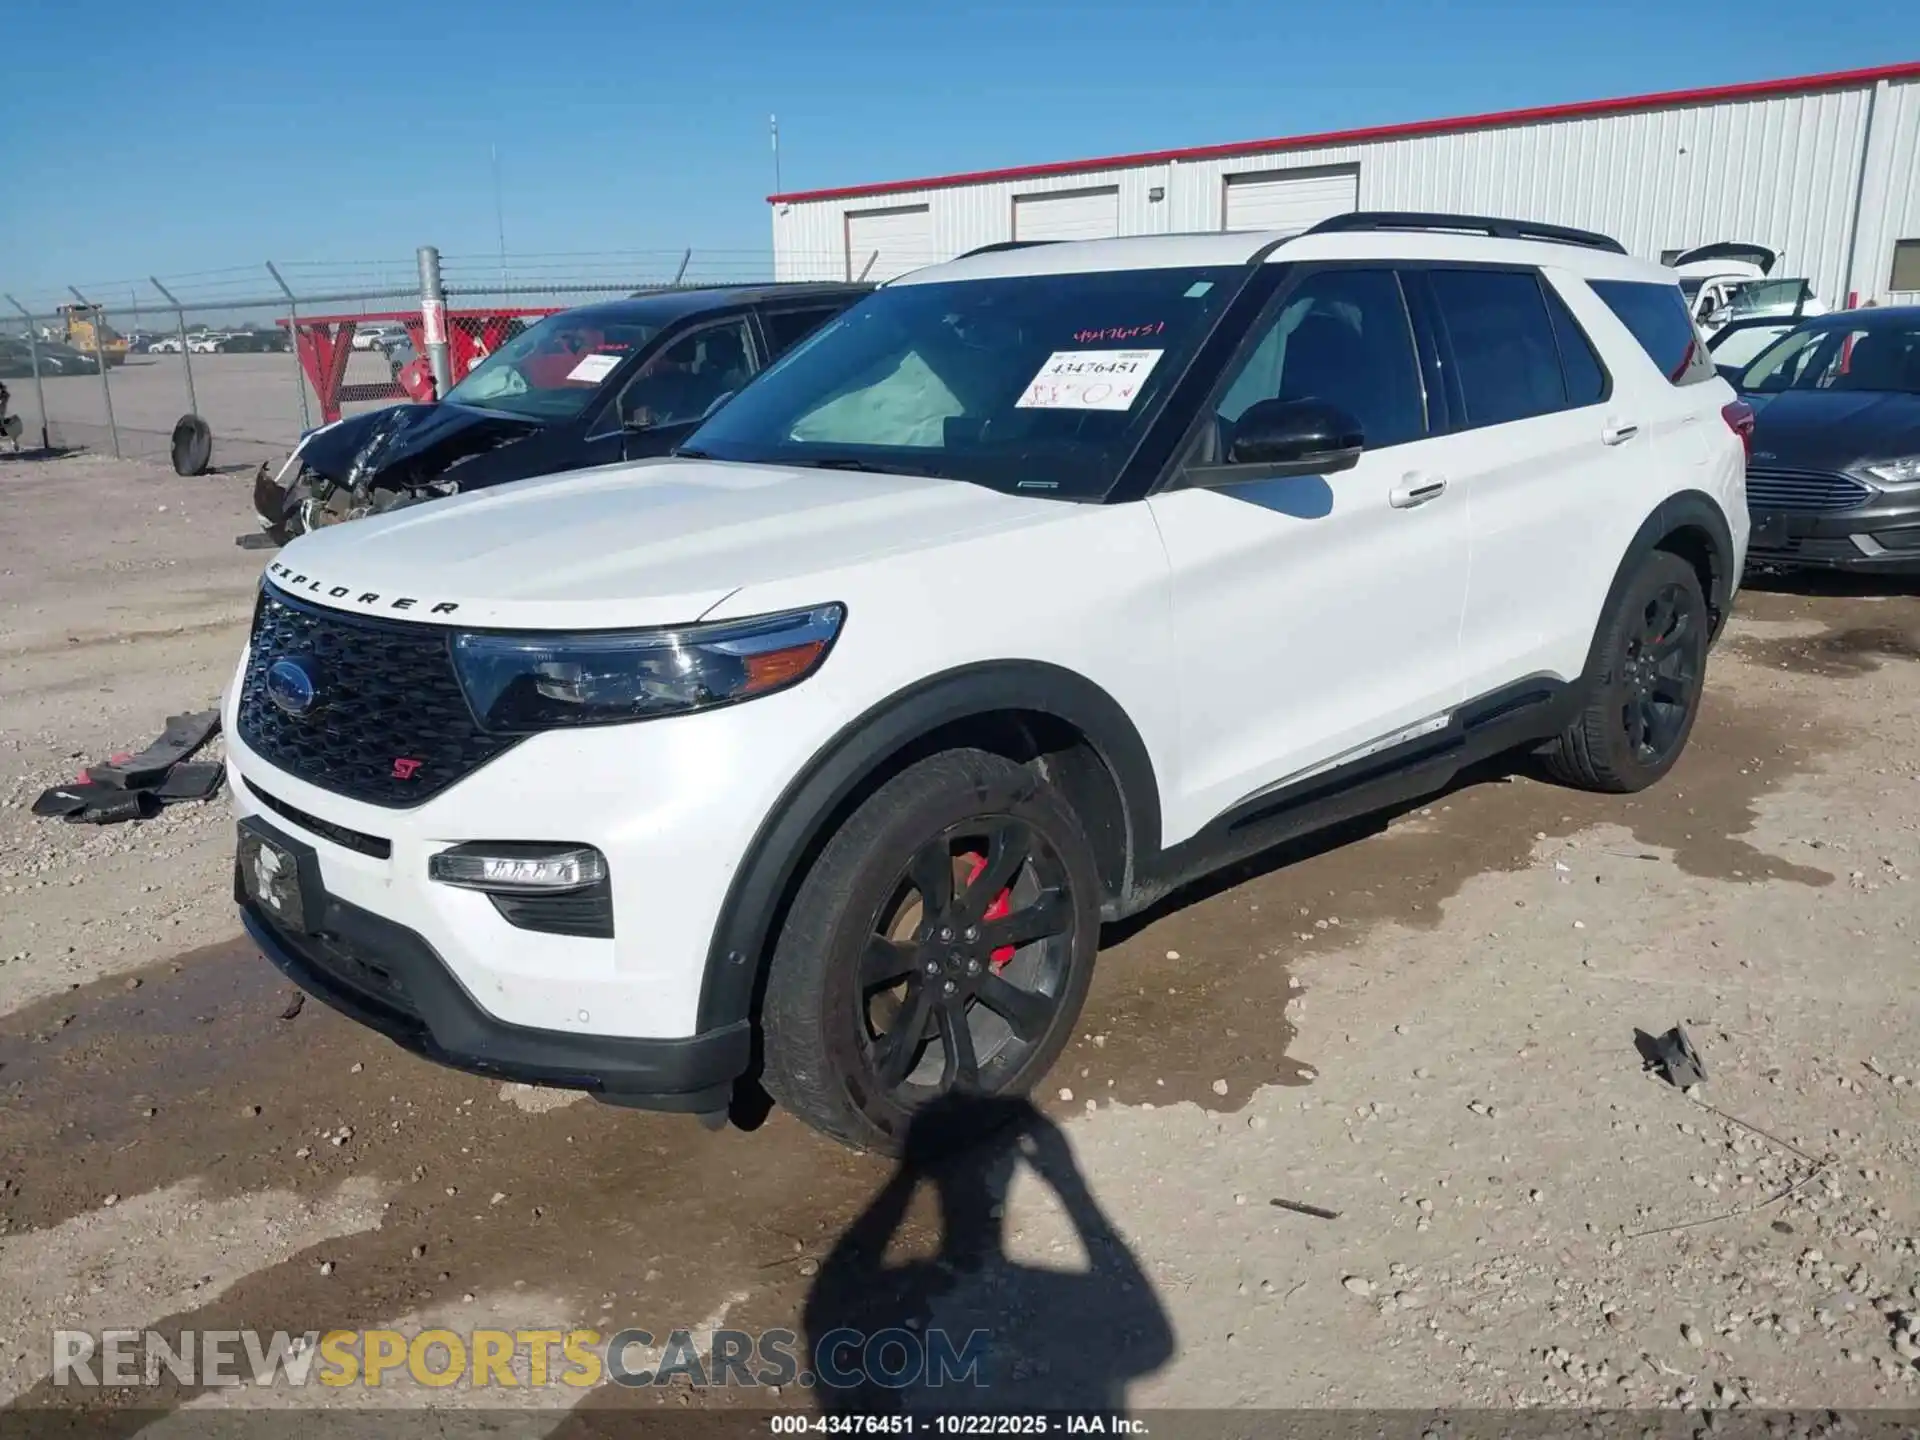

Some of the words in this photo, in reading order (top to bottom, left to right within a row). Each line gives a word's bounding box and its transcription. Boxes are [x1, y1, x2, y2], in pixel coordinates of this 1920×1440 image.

[1051, 362, 1138, 374] 43476451
[270, 562, 459, 614] EXPLORER
[391, 758, 422, 779] ST
